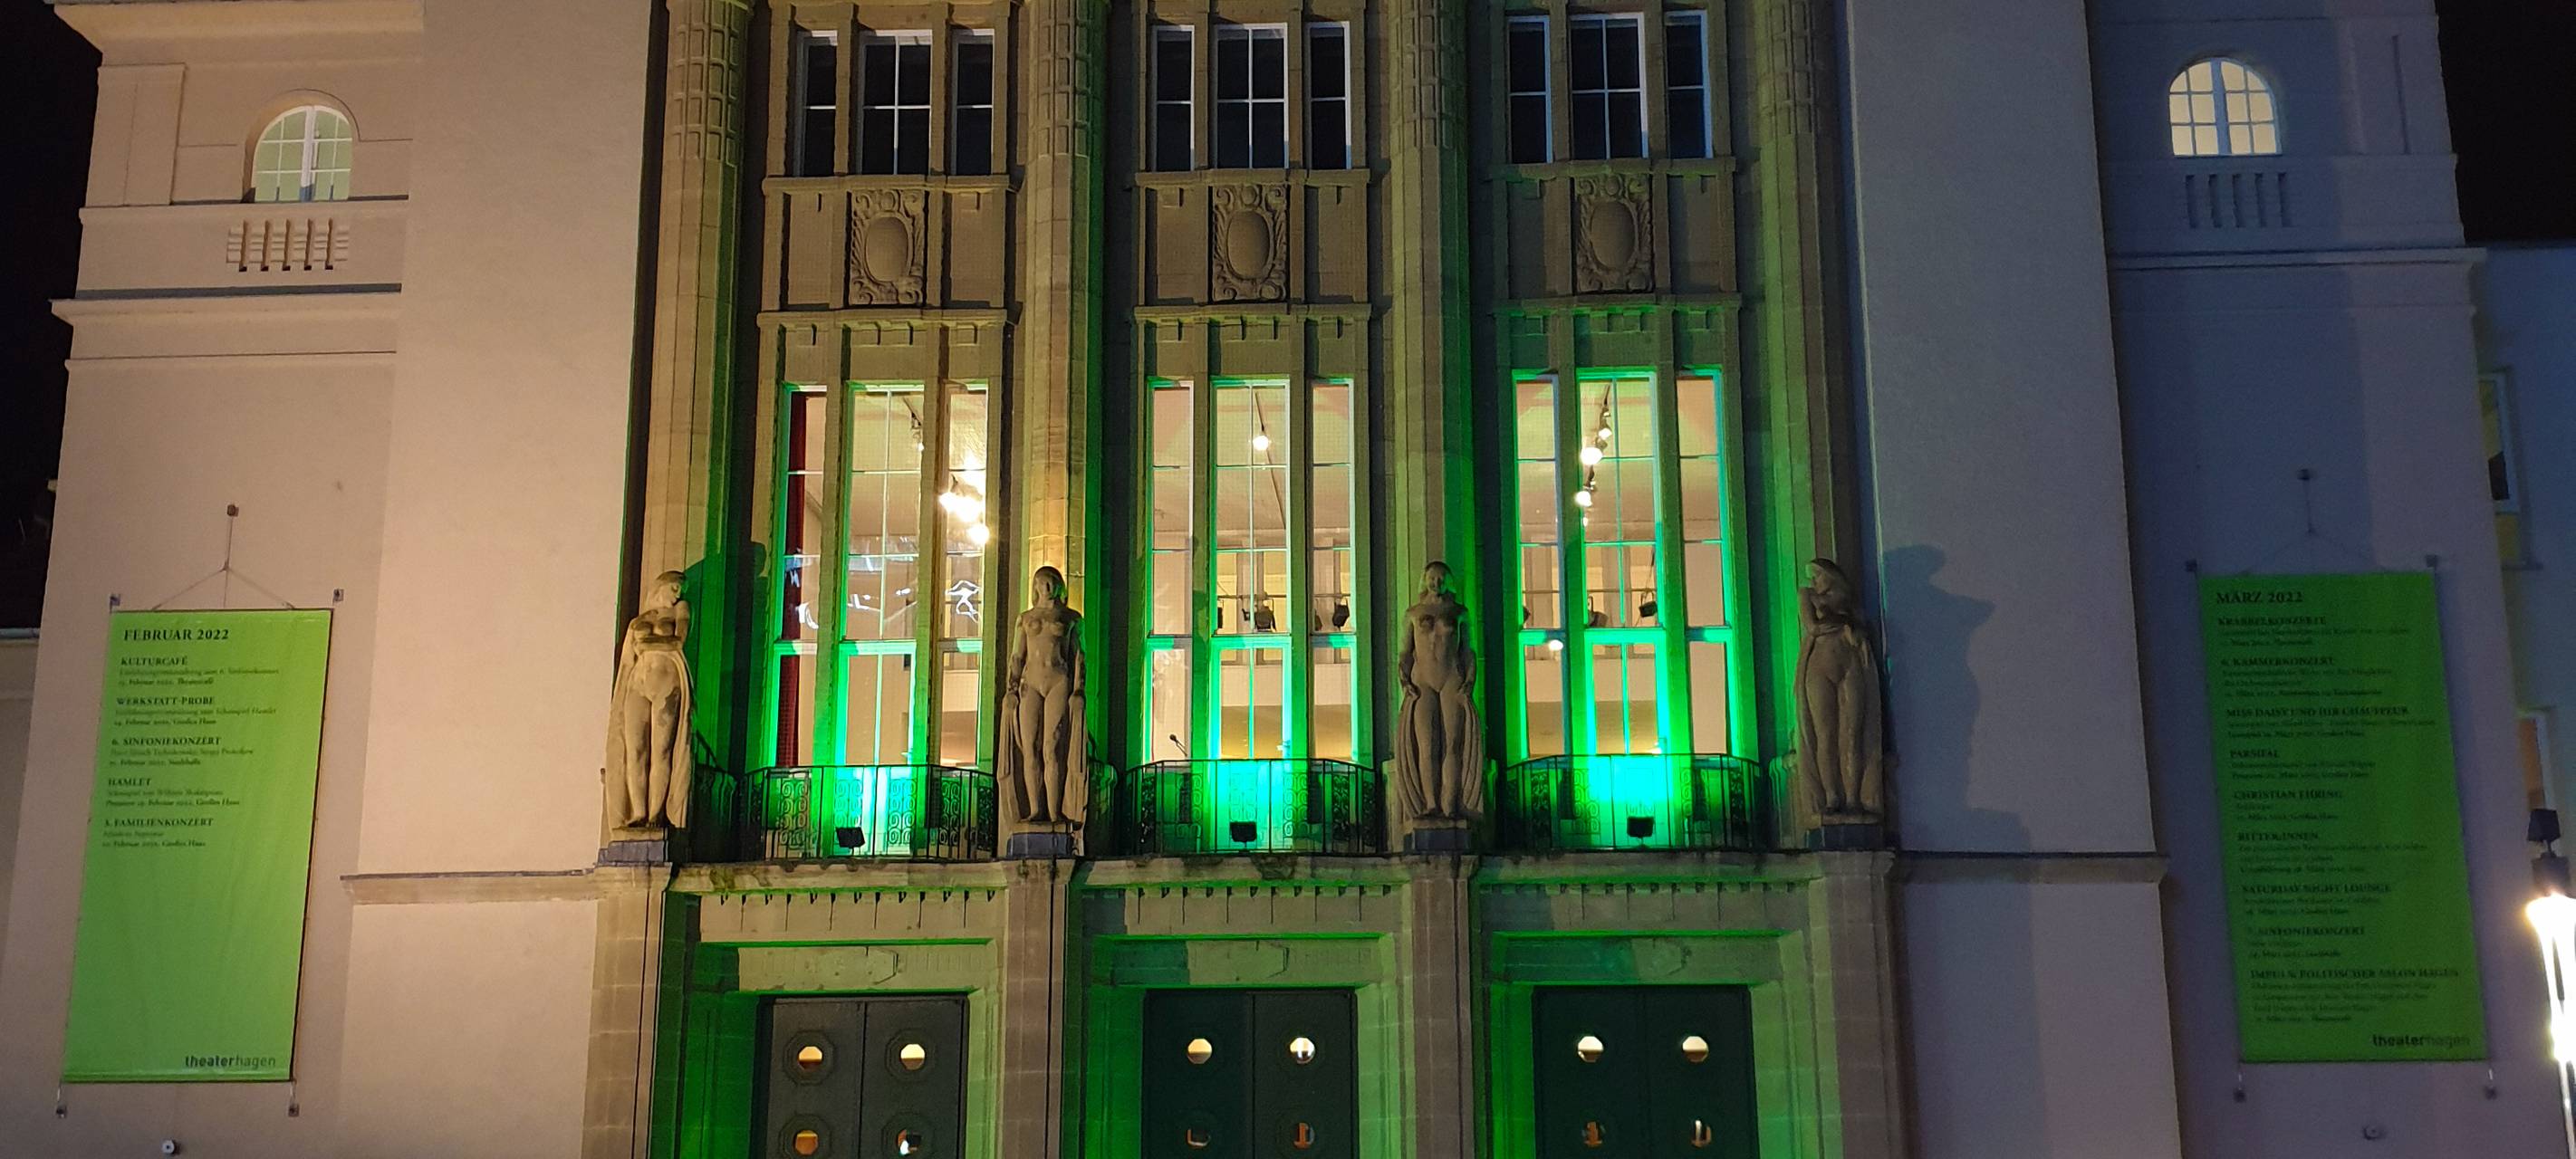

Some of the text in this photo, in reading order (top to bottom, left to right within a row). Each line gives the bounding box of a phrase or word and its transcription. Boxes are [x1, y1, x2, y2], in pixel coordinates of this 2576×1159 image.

[2267, 590, 2303, 604] 2022
[124, 628, 230, 641] FEBRUAR 2022
[120, 655, 188, 666] KULTURCAFÉ
[2232, 656, 2335, 666] KAMMERKONZERT
[116, 695, 216, 705] WERKSTATT-PROBE
[2226, 708, 2254, 717] MISS
[122, 736, 222, 746] SINFONIEKONZERT
[108, 778, 152, 786] HAMLET
[2233, 790, 2296, 799] CHRISTIAN
[114, 818, 215, 828] FAMILIENKONZERT
[2258, 926, 2365, 935] SINFONIEKONZERT
[2372, 1033, 2471, 1049] theaterhagen
[184, 1055, 276, 1069] theaterhagen
